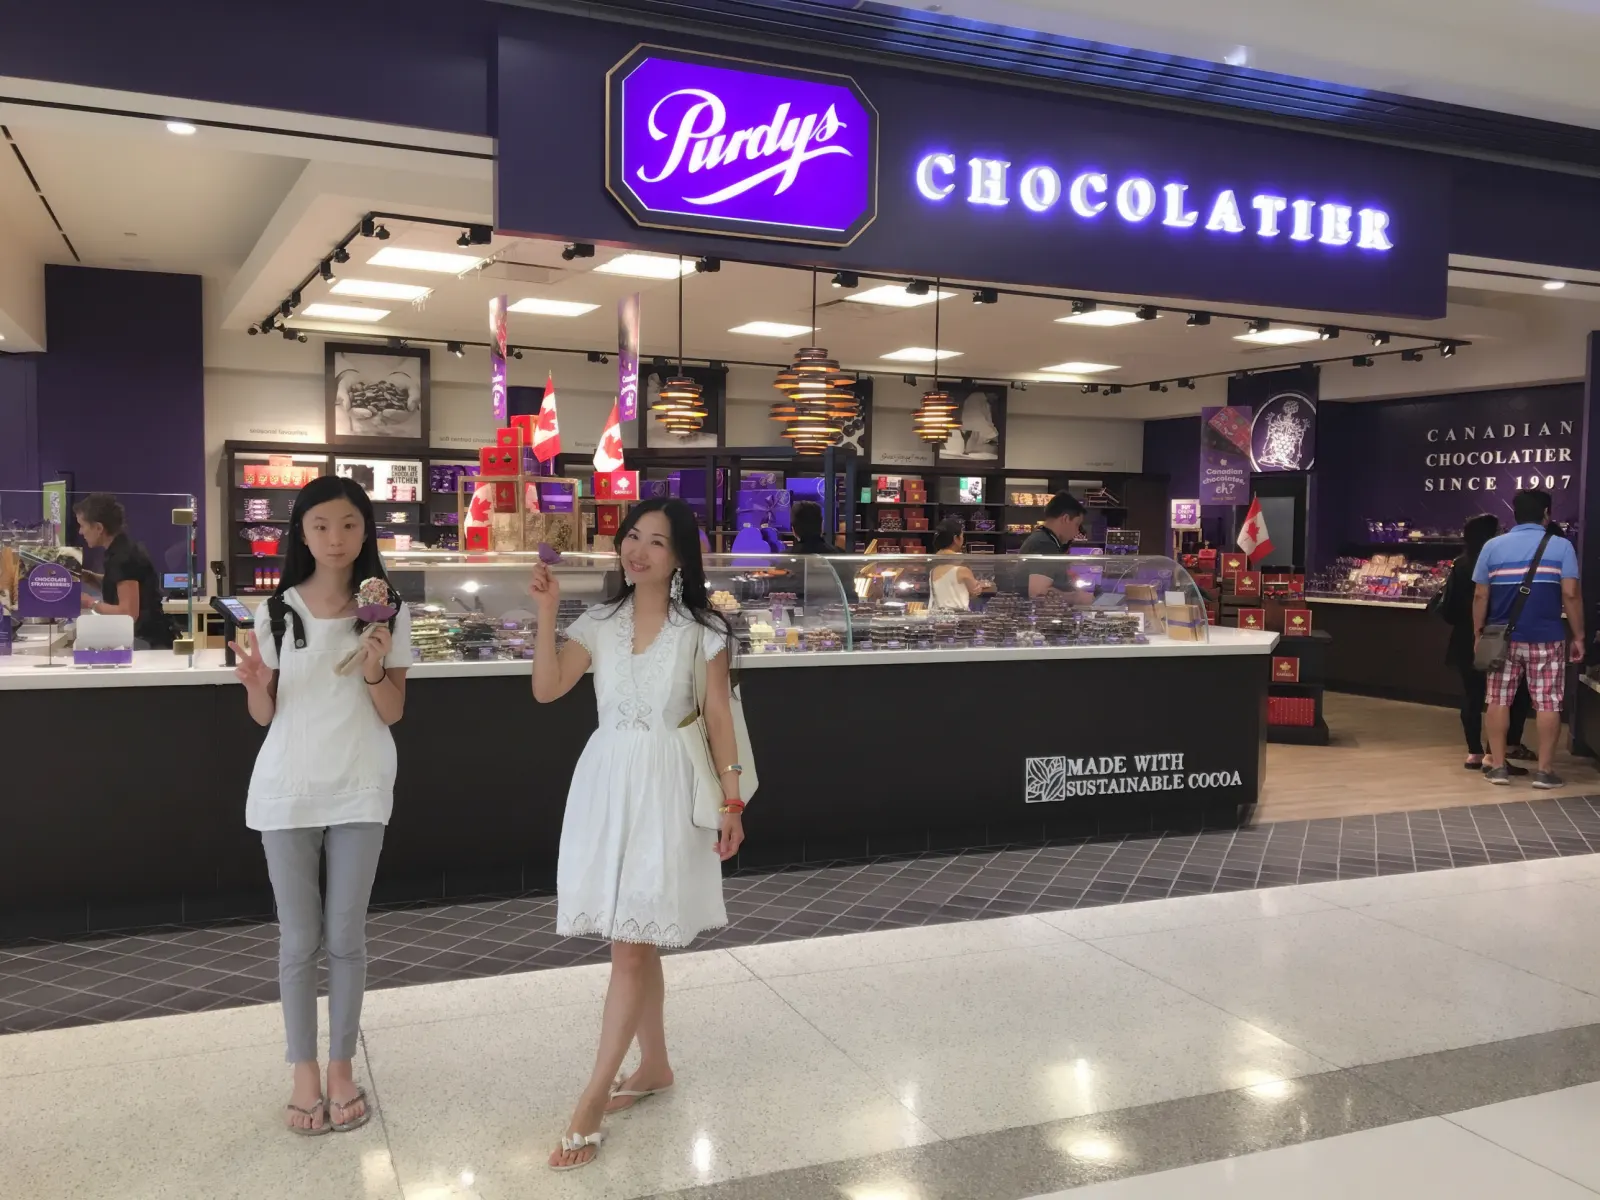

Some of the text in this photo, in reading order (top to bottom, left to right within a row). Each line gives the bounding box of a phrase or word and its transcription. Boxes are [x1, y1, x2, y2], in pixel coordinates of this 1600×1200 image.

[636, 88, 853, 205] Purdys
[915, 153, 1394, 250] CHOCOLATIER
[1427, 421, 1573, 442] CANADIAN
[1426, 448, 1572, 467] CHOCOLATIER
[1202, 475, 1246, 486] chocolates,
[1215, 482, 1235, 494] eh?
[1425, 475, 1571, 492] SINCE 1907
[1066, 753, 1184, 776] MADE WITH
[1066, 770, 1242, 797] SUSTAINABLE COCOA
